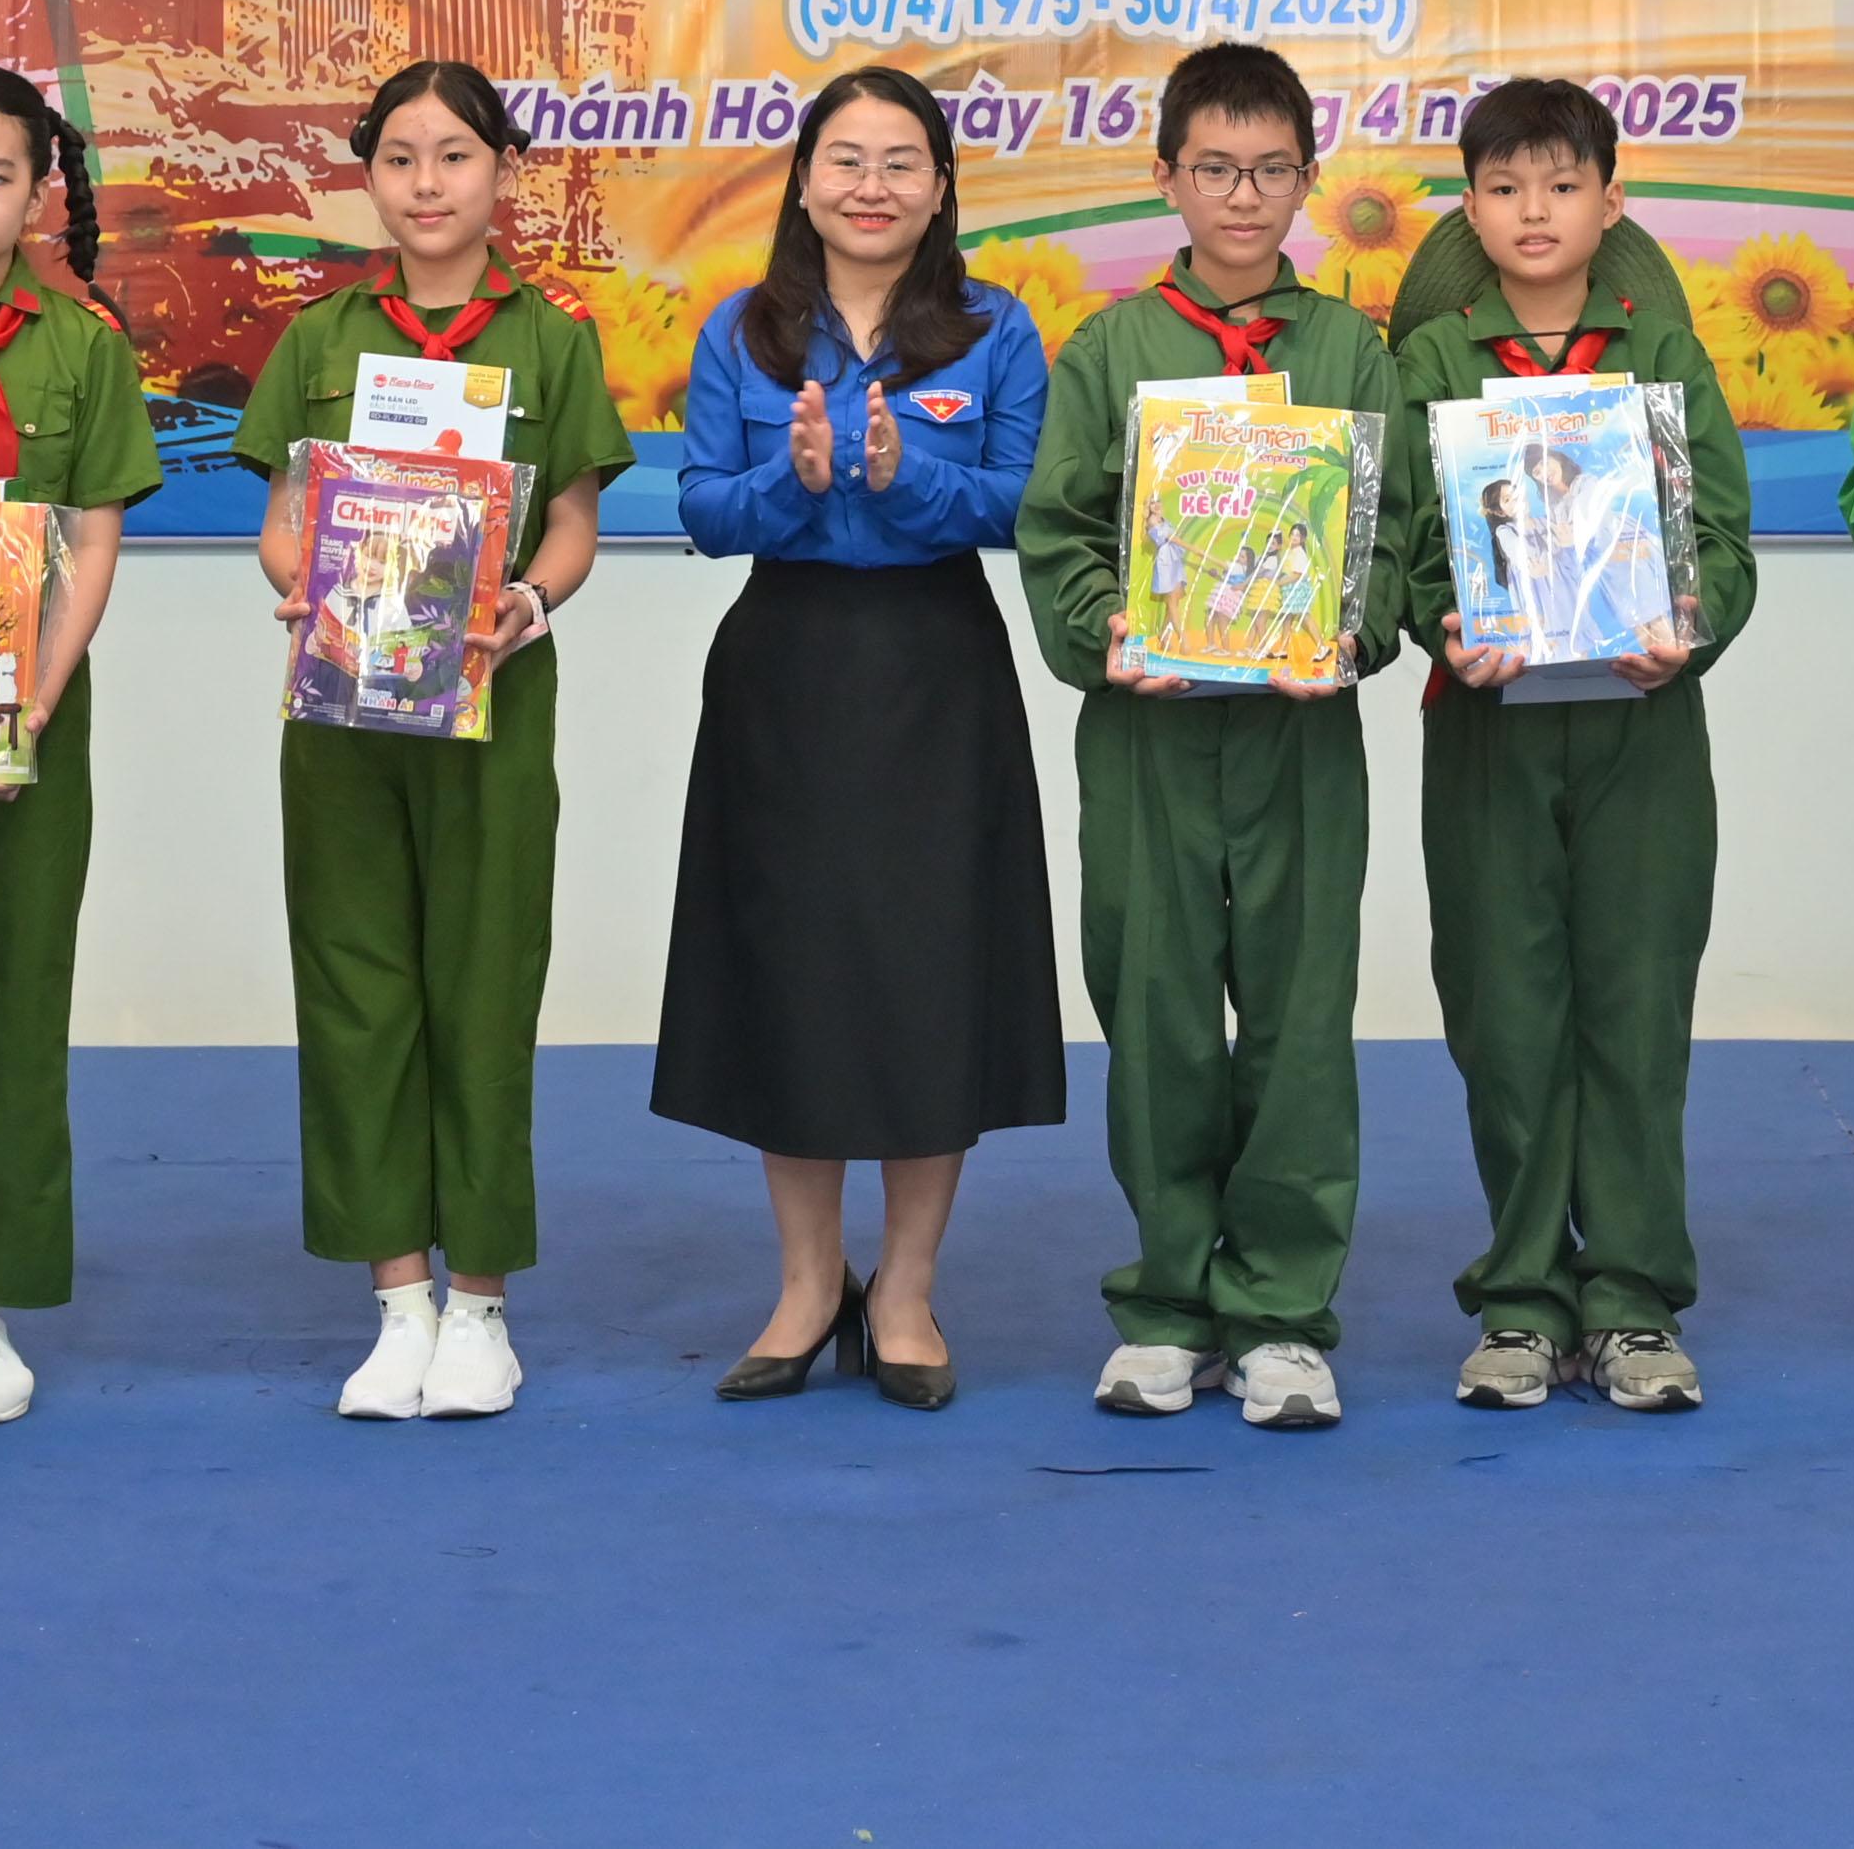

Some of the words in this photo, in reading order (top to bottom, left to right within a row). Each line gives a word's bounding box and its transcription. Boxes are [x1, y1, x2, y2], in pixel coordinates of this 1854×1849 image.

[498, 80, 687, 141] Khánh
[1069, 84, 1136, 139] 16
[1360, 83, 1401, 137] 4
